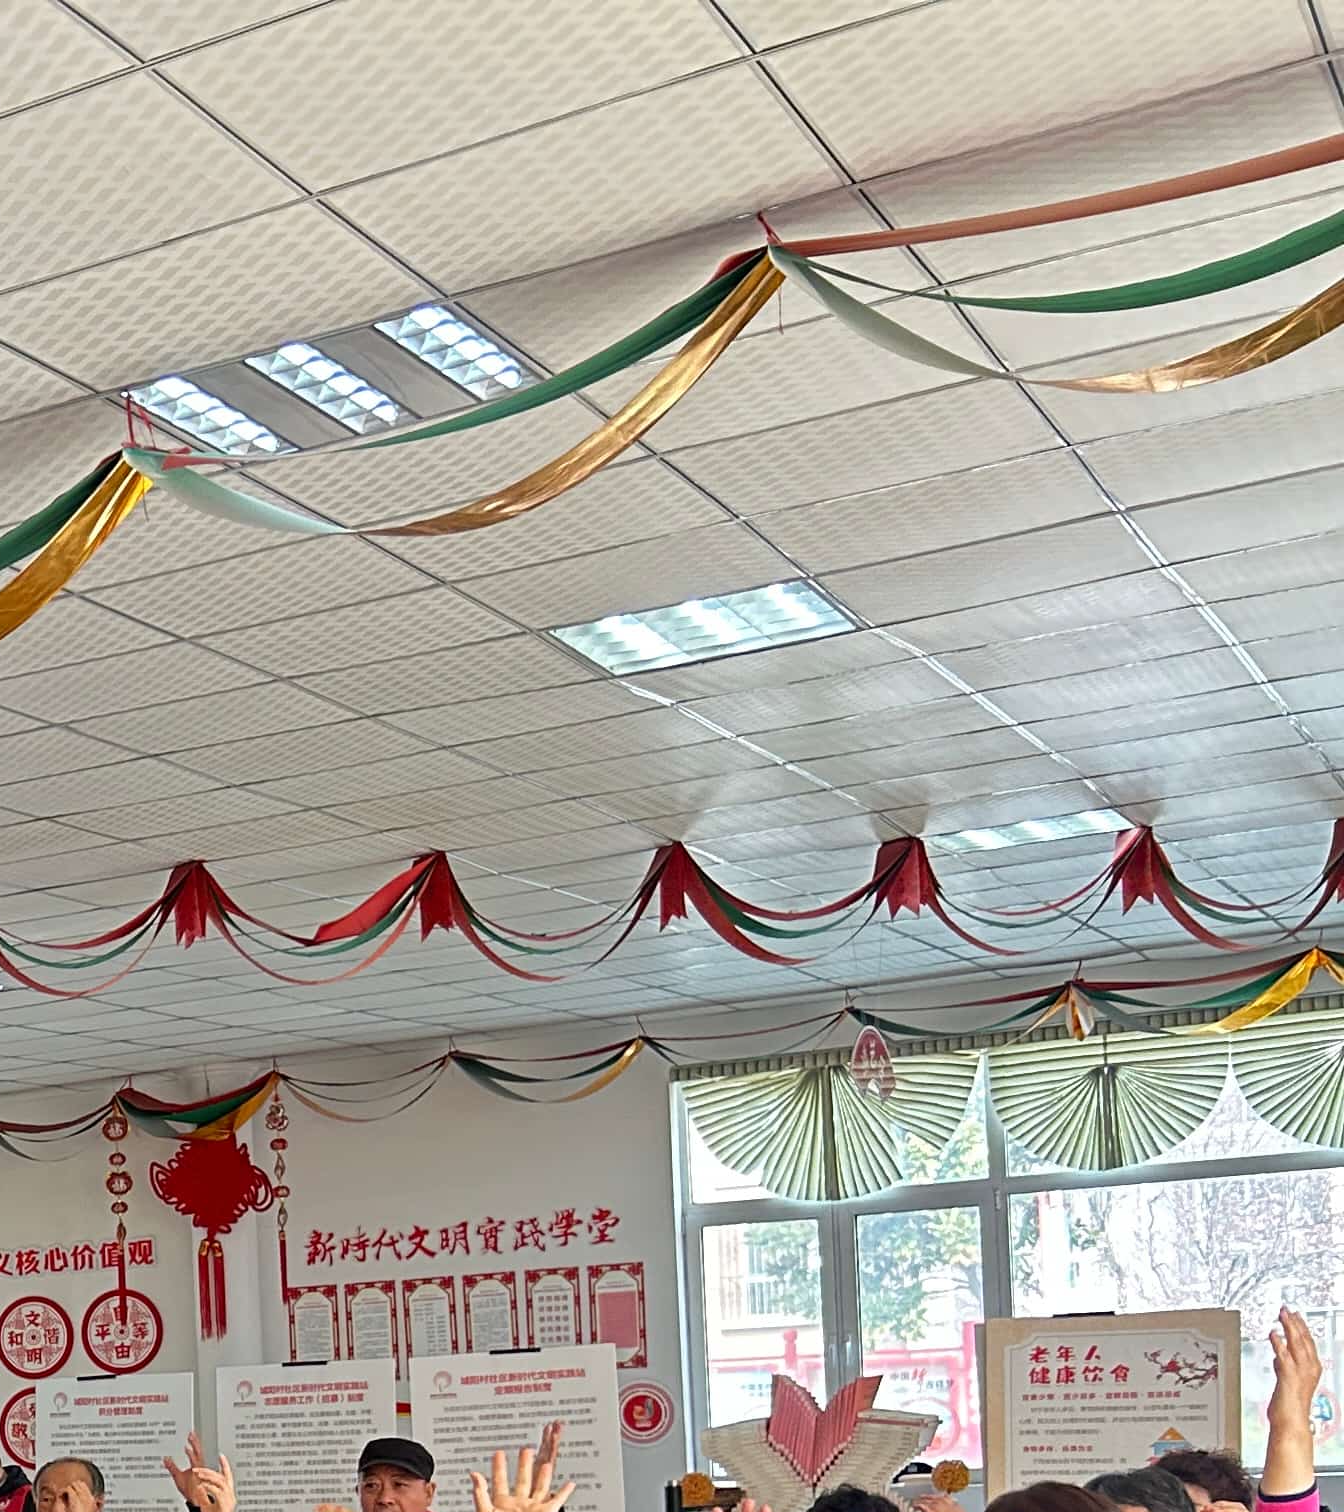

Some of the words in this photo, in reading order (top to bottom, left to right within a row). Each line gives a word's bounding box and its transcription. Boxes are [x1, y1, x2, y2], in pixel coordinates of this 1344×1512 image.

[1029, 1345, 1100, 1363] 老年人
[1029, 1364, 1130, 1385] 健康饮食
